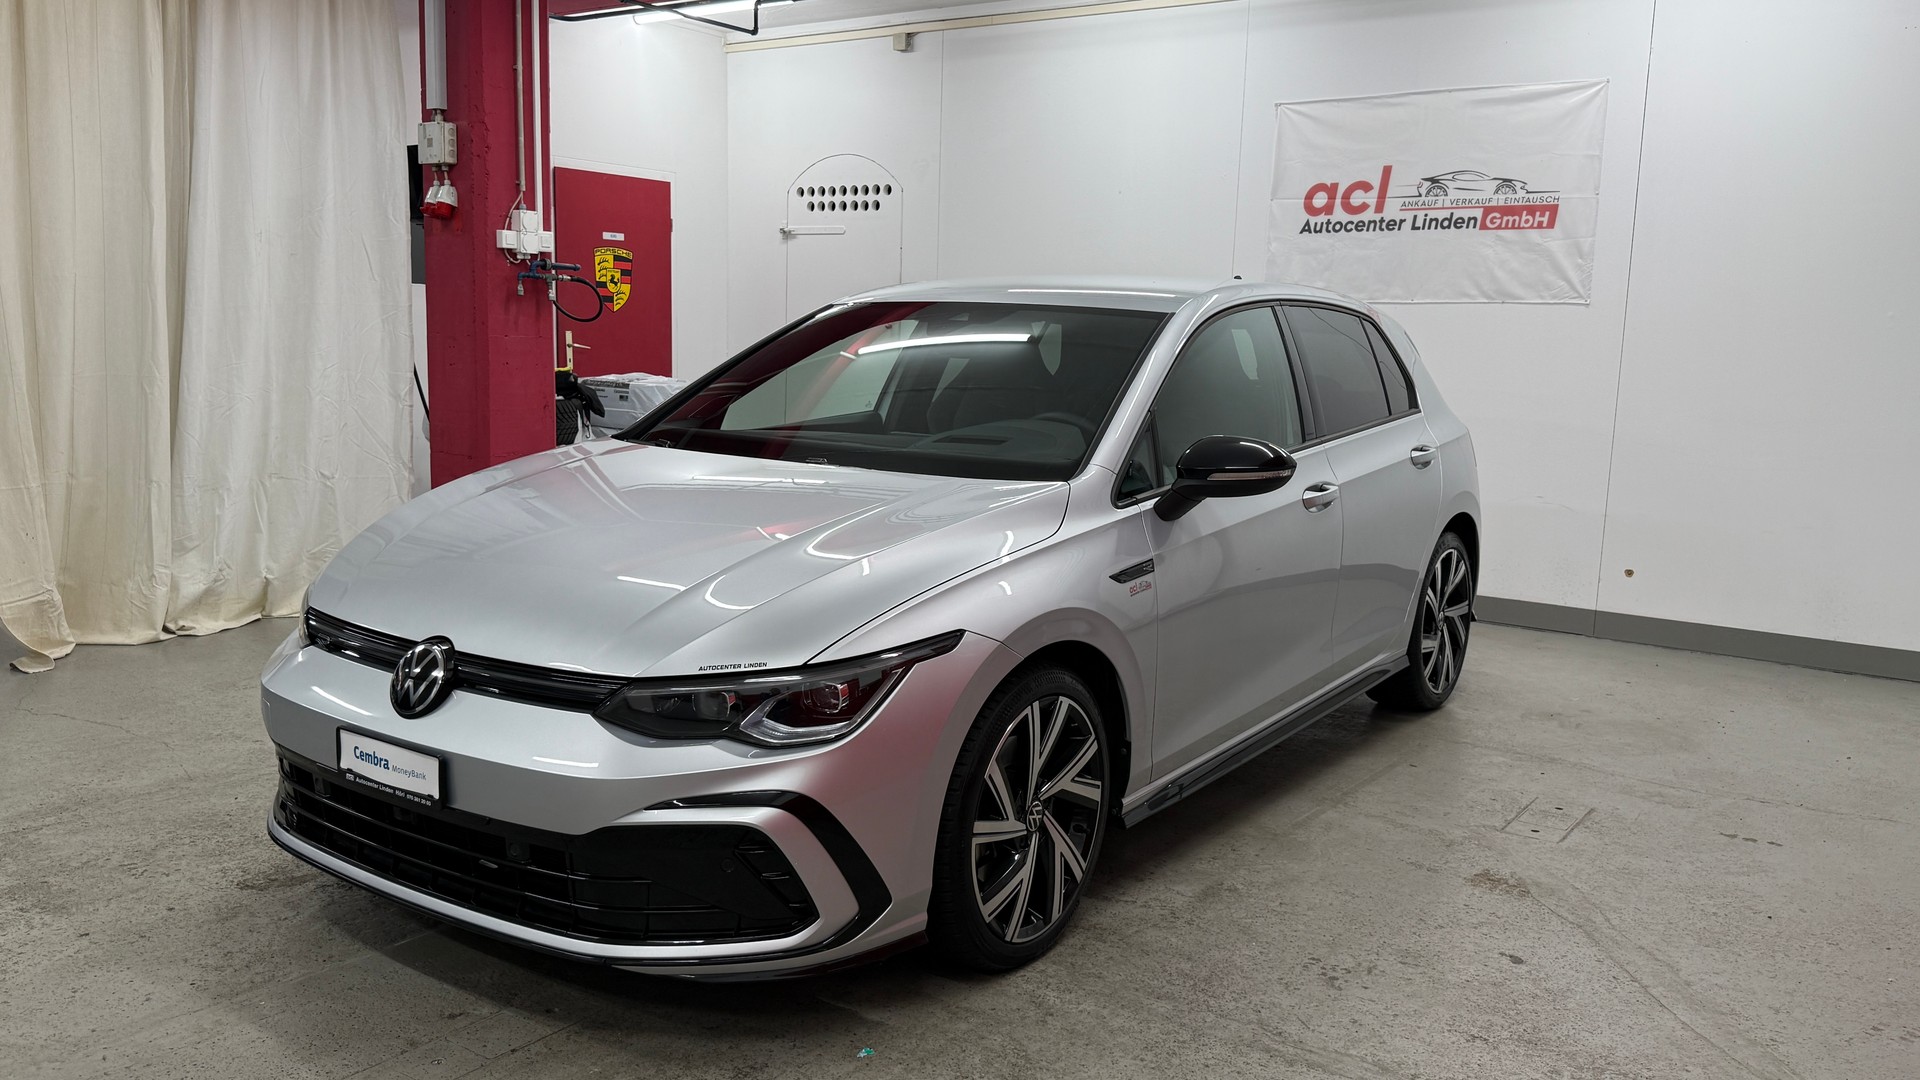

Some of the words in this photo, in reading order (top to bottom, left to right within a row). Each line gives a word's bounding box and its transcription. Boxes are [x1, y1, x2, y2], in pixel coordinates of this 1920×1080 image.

[1303, 165, 1393, 217] acl
[1400, 199, 1440, 208] ANKAUF
[1449, 197, 1494, 206] VERKAUF
[1503, 195, 1561, 204] EINTAUSCH
[1299, 214, 1406, 234] Autocenter
[1411, 212, 1478, 231] Linden
[1485, 210, 1550, 229] GmbH
[595, 247, 632, 258] PORSCHE
[698, 663, 742, 672] AUTOCENTER
[353, 745, 390, 771] Cembra
[391, 764, 427, 781] MoneyBank
[355, 777, 379, 789] Autocenter
